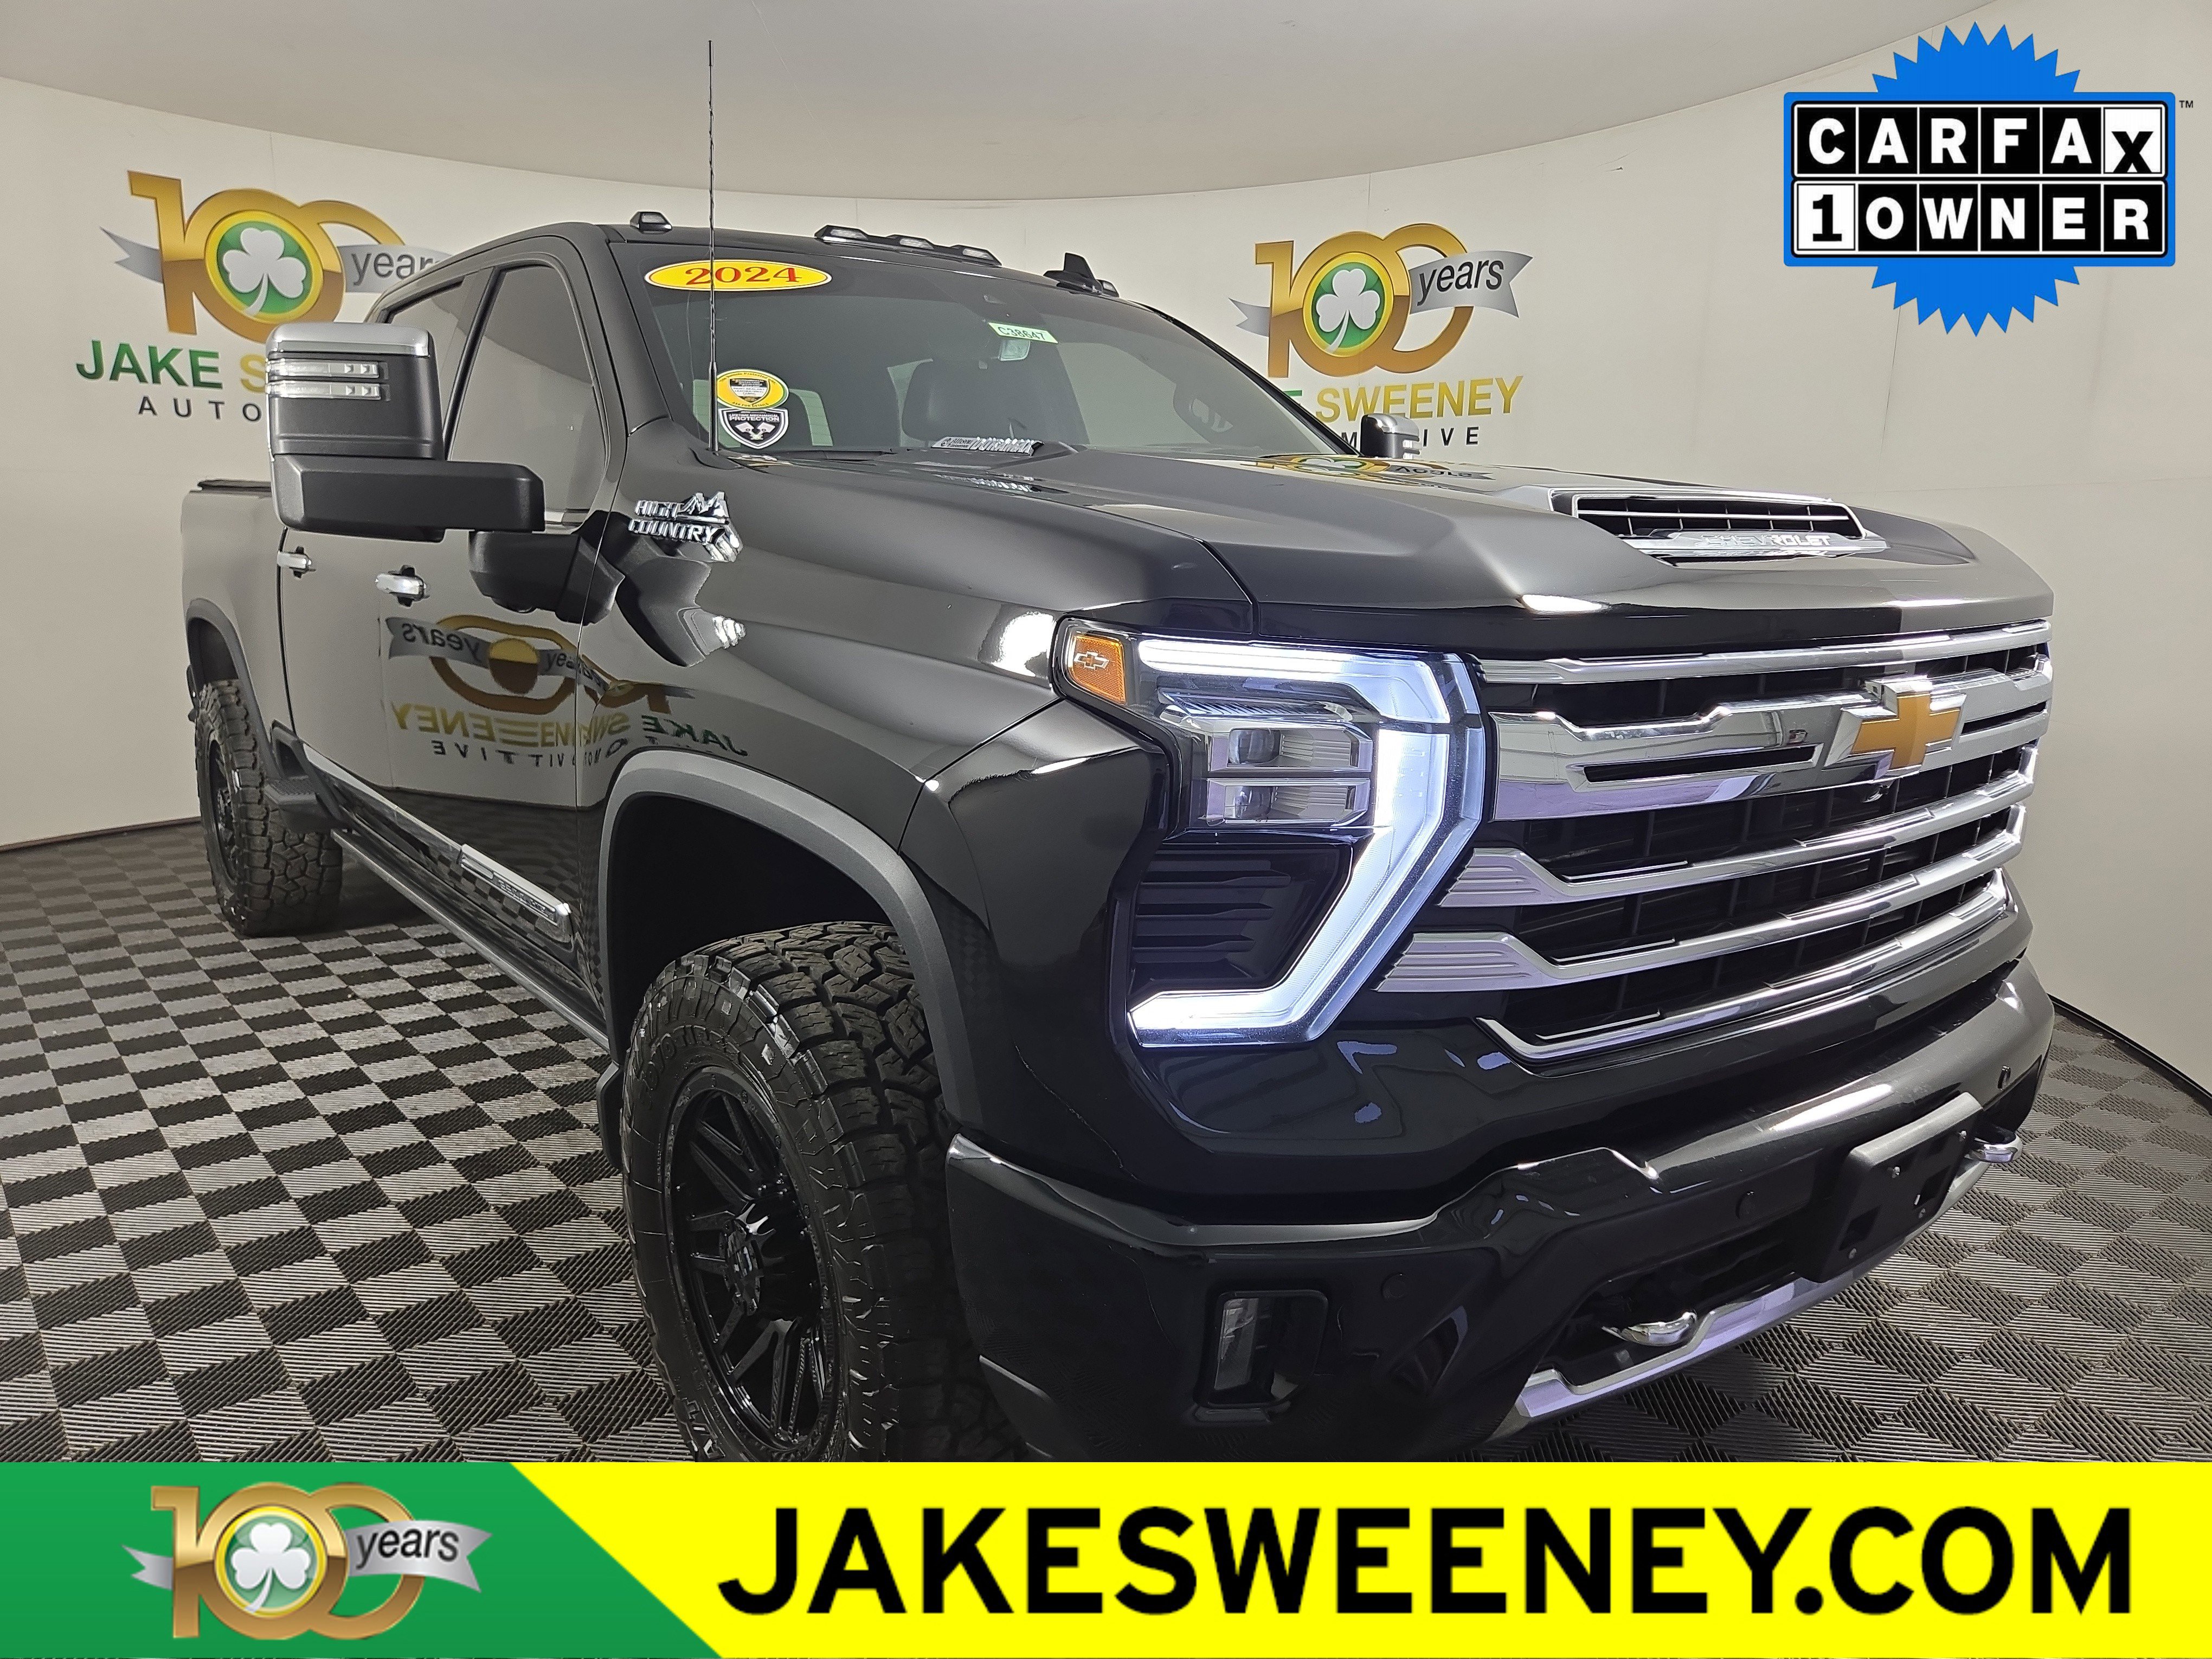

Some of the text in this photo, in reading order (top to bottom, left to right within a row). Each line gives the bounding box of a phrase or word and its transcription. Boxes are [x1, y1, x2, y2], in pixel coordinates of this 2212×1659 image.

[351, 252, 440, 286] year
[685, 267, 802, 286] 2024
[1417, 259, 1504, 307] years
[1255, 223, 1474, 378] 100
[998, 326, 1046, 341] C38647
[76, 339, 223, 389] JAKE
[1315, 375, 1523, 423] SWEENEY
[628, 519, 718, 545] COUNTRY
[1701, 534, 1831, 546] CHEVROLET
